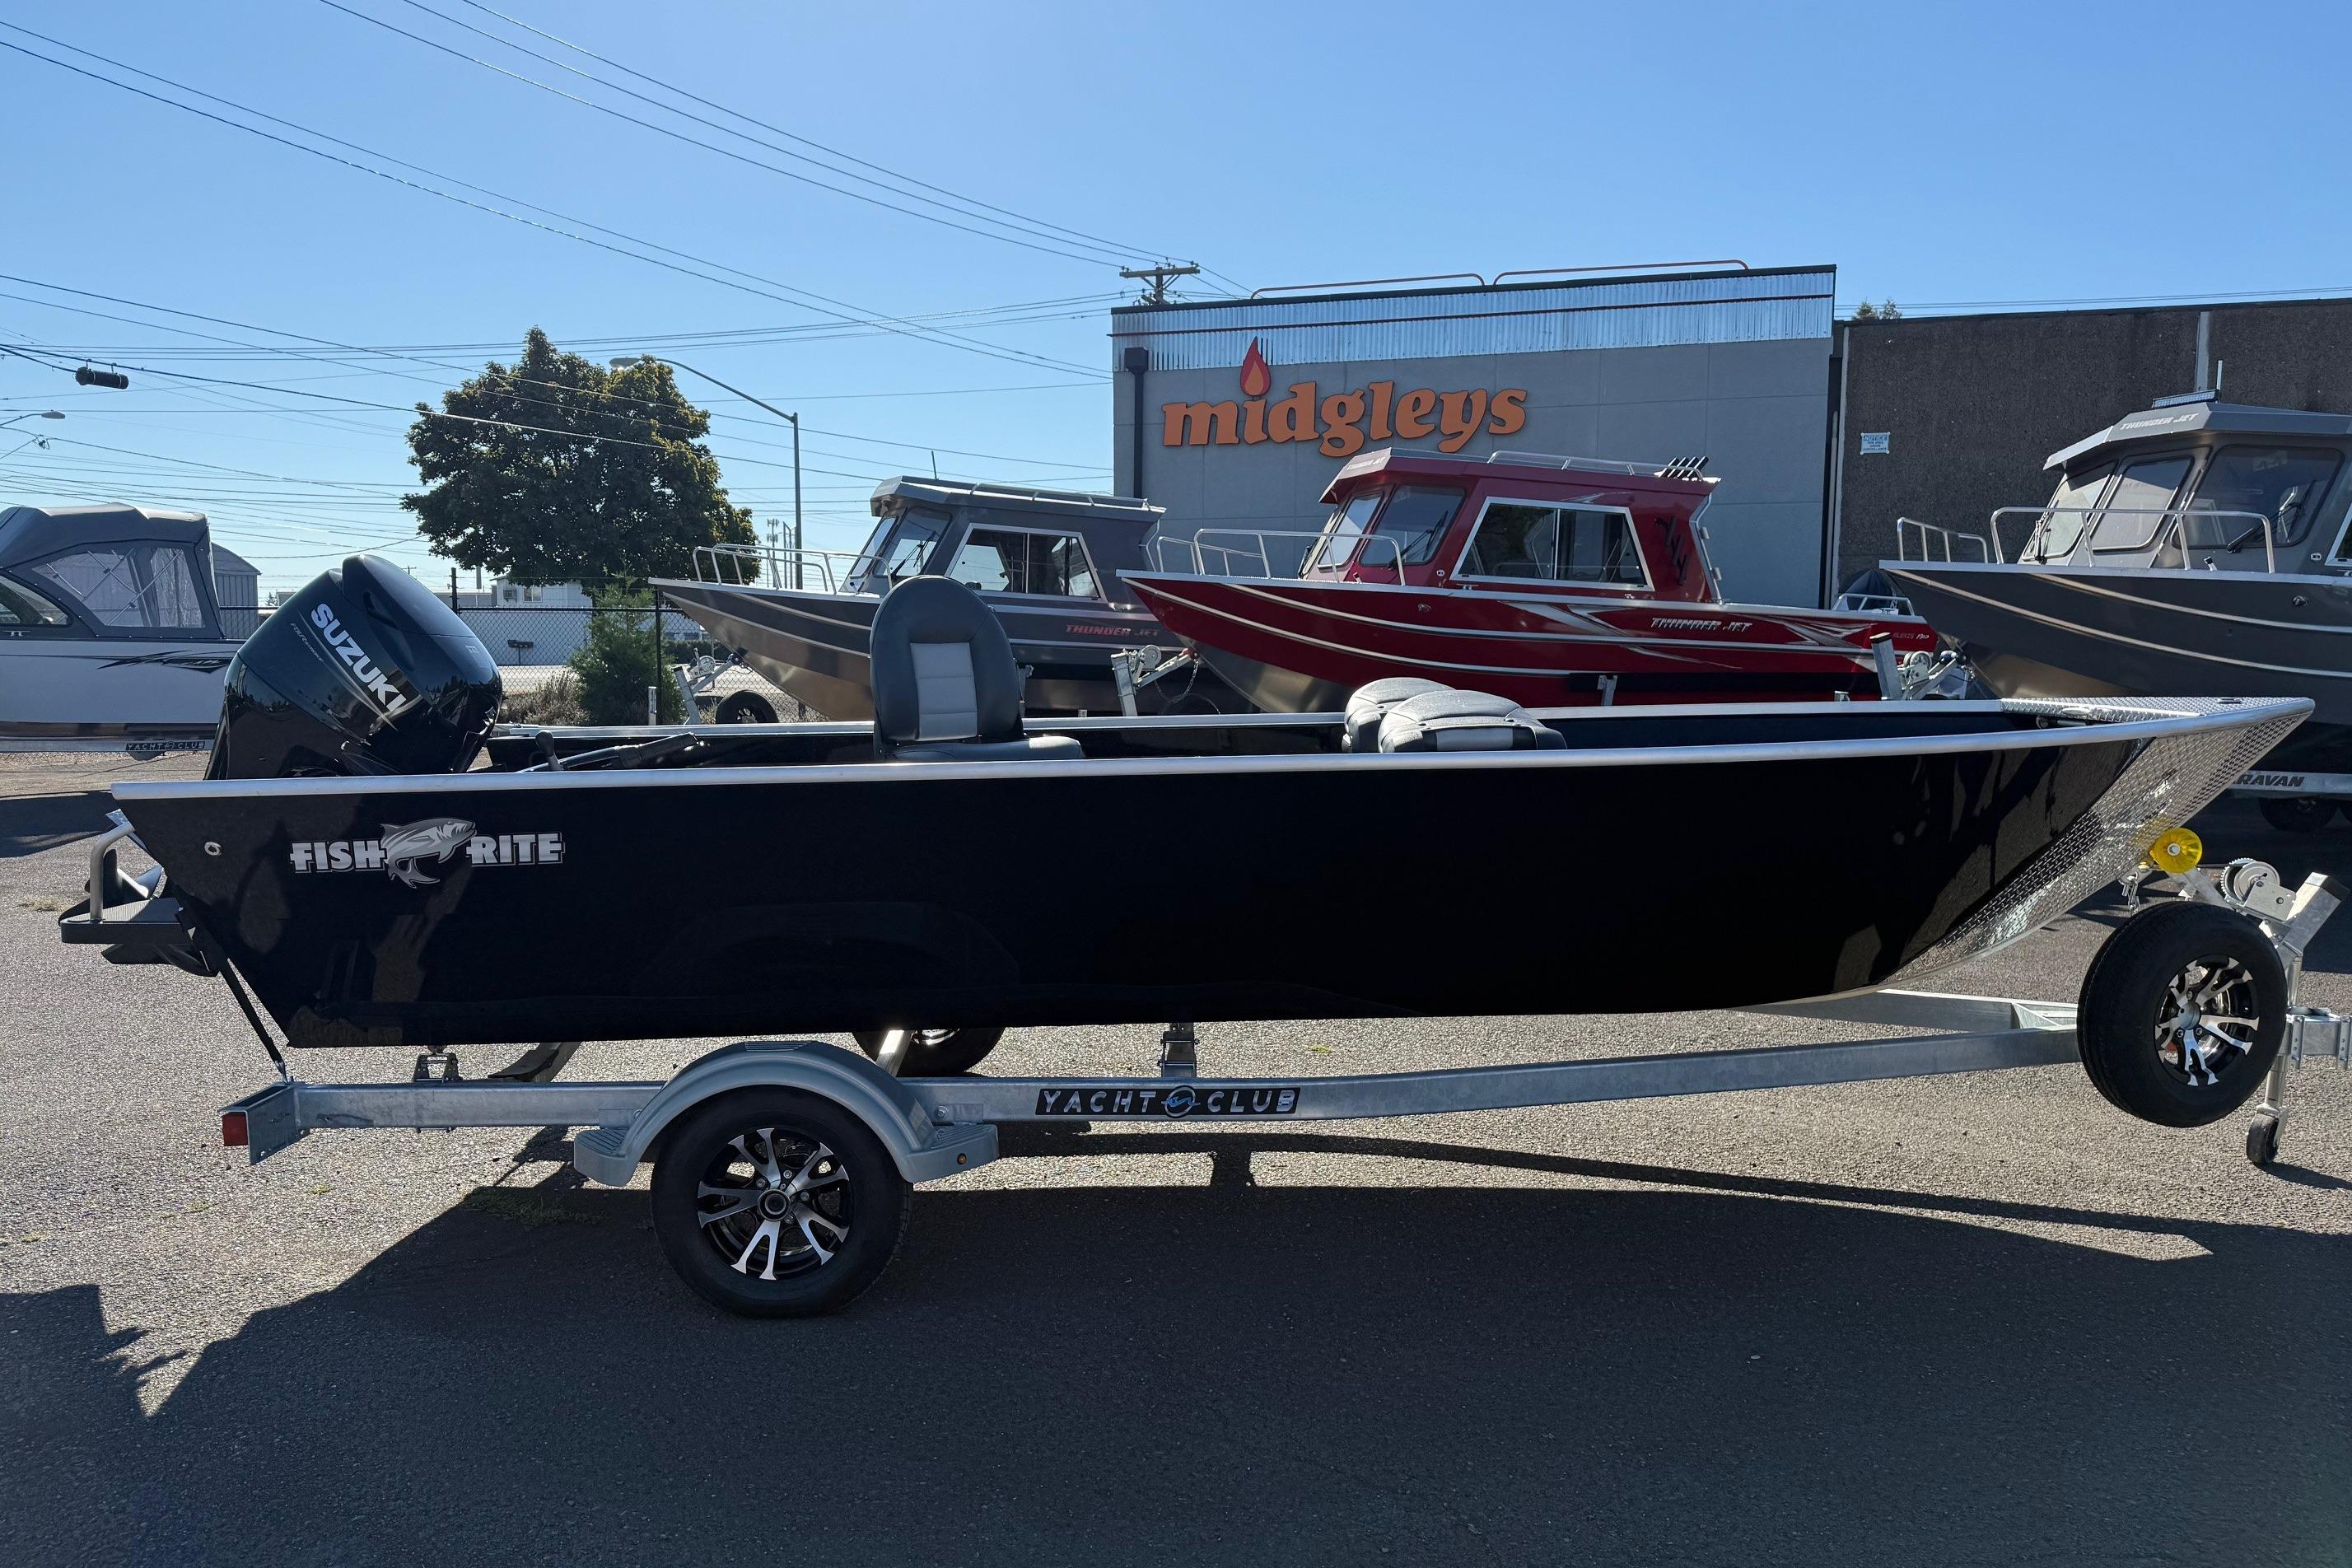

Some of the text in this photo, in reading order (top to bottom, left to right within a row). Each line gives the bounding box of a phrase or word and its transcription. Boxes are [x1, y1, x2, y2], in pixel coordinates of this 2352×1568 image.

[1162, 337, 1528, 457] midgleys
[2120, 413, 2200, 430] THUNDER JET
[1065, 624, 1161, 637] THUNDER JET
[1650, 618, 1753, 632] THUNDER JET
[310, 603, 407, 712] SUZUKI
[2232, 774, 2305, 786] RAVAN
[290, 832, 565, 873] FISH RITE
[1043, 1090, 1297, 1113] YACHT CLUB
